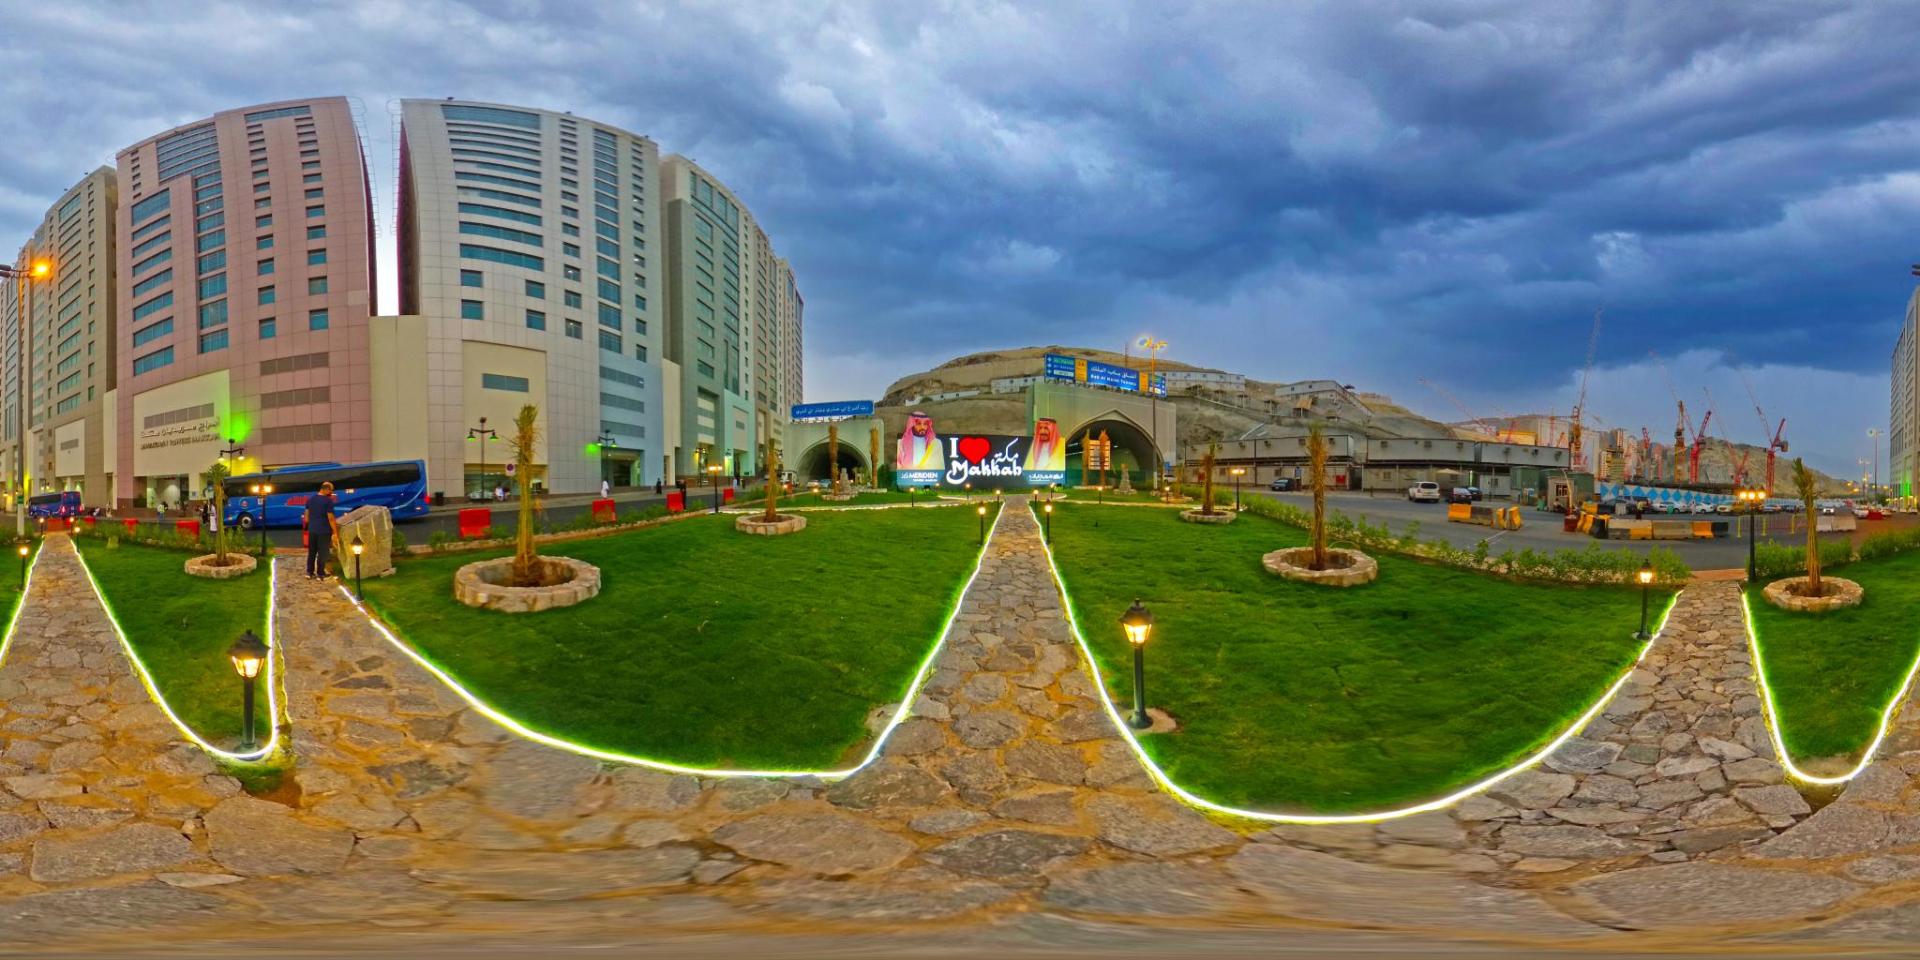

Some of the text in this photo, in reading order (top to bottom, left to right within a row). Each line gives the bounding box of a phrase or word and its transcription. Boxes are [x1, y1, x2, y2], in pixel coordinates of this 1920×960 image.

[949, 437, 959, 458] I
[994, 437, 1019, 464] مكة
[946, 459, 1023, 485] Makkah
